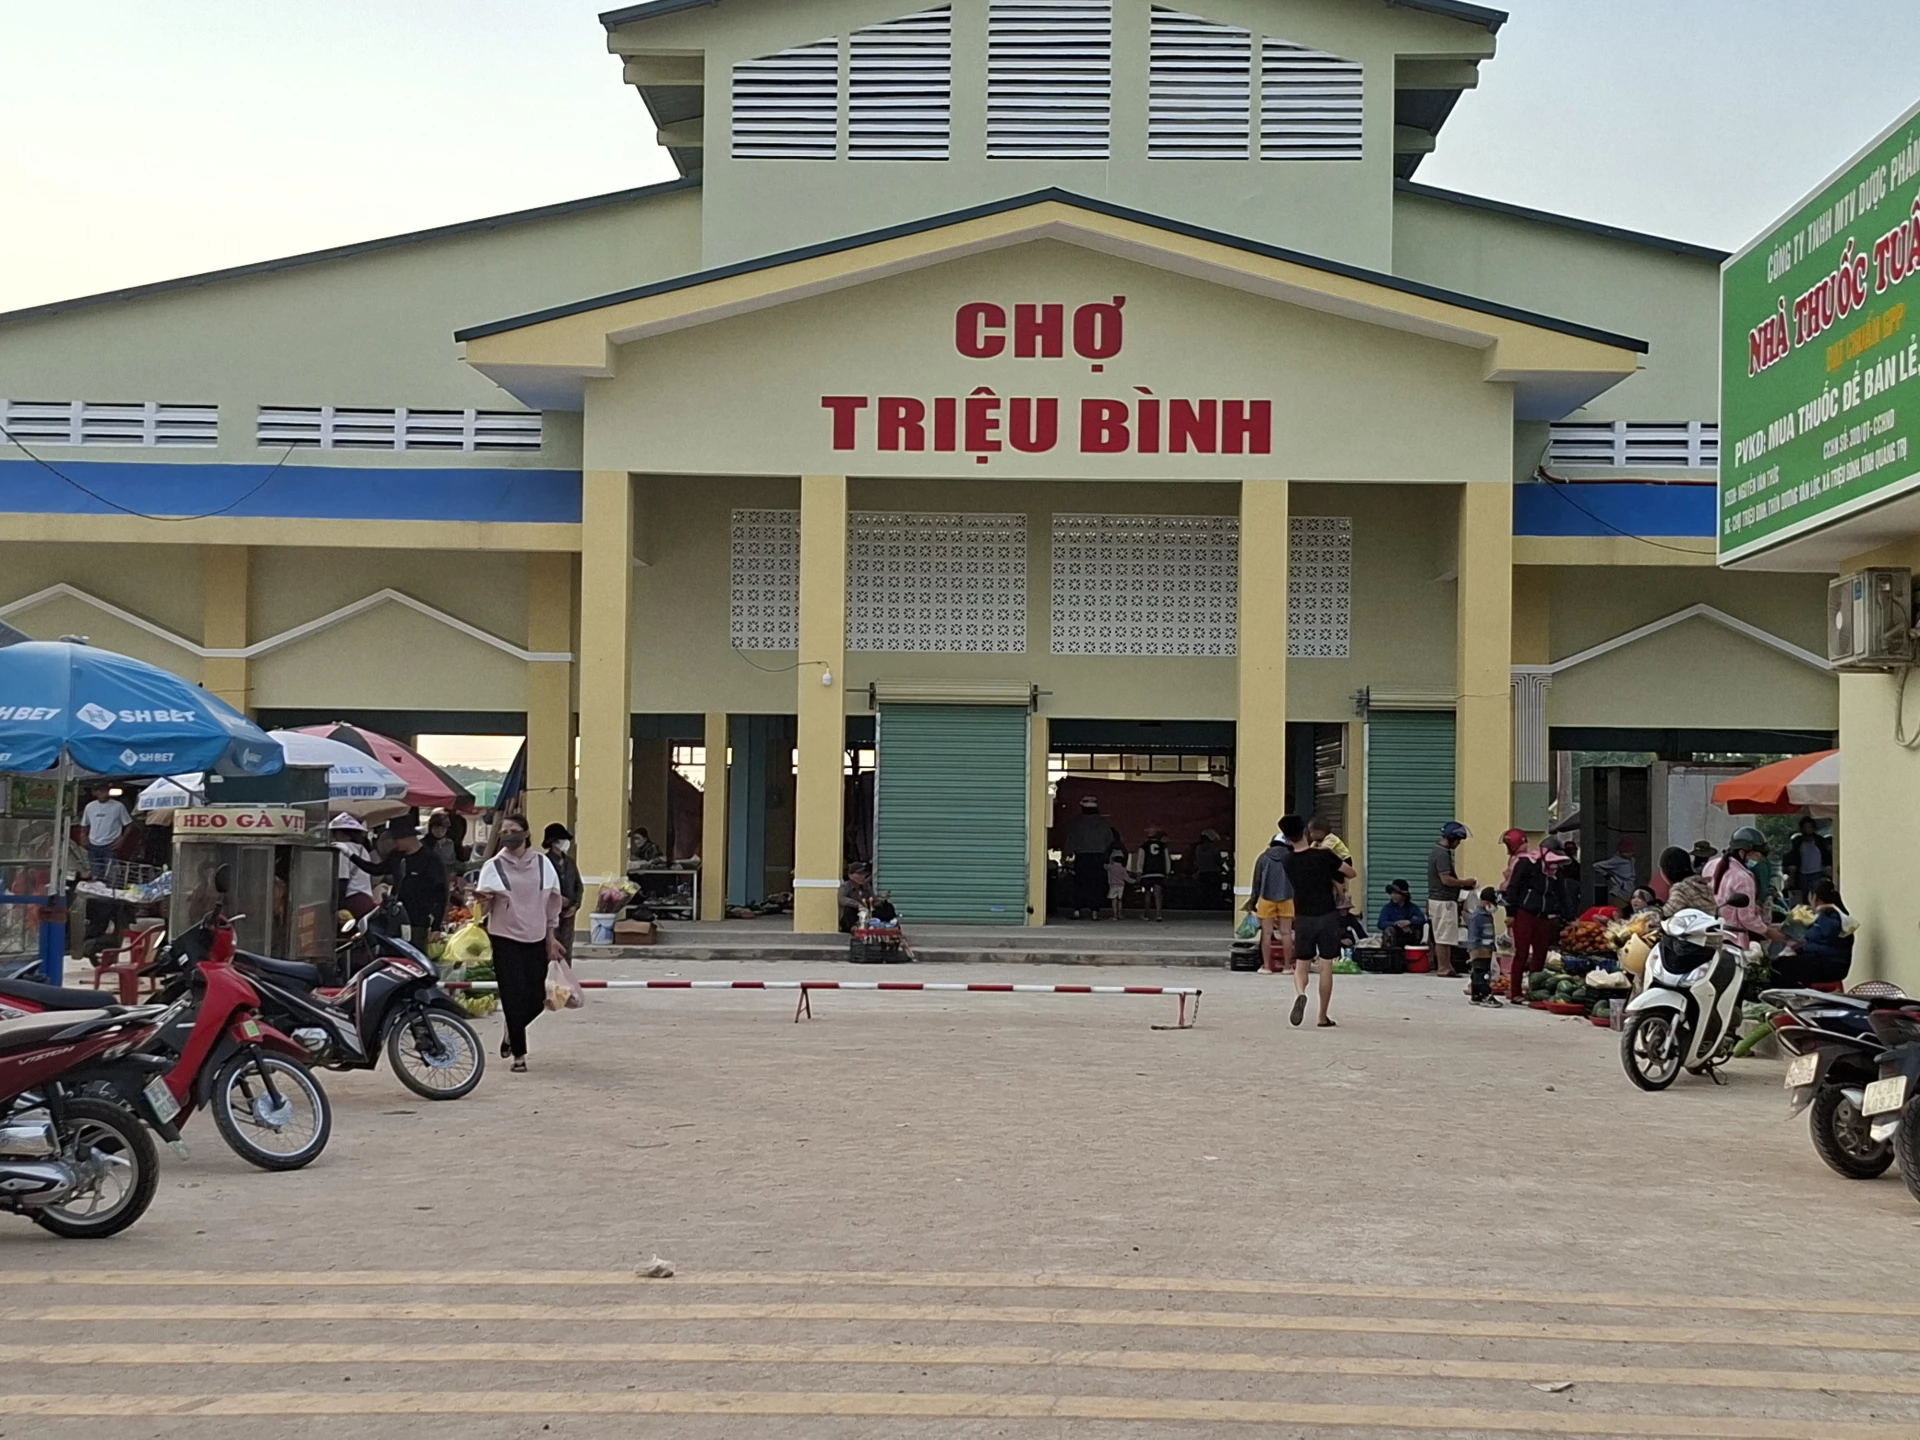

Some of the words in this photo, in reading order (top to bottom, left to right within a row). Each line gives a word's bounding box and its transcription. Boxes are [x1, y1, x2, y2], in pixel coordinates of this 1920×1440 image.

[1767, 244, 1791, 283] CÔNG
[1793, 230, 1805, 265] TY
[1807, 208, 1833, 254] TNHH
[1834, 189, 1856, 234] MTV
[1858, 165, 1887, 215] DƯỢC
[955, 295, 1127, 373] CHỢ
[1748, 295, 1790, 378] NHÀ
[1793, 236, 1867, 349] THUỐC
[820, 386, 1059, 464] TRIỆU
[1080, 386, 1272, 454] BÌNH
[1768, 413, 1795, 450] MUA
[1798, 380, 1839, 435] THUỐC
[1864, 356, 1896, 400] BÁN
[183, 814, 228, 828] HEO
[236, 810, 275, 828] GÀ
[1150, 843, 1160, 855] C
